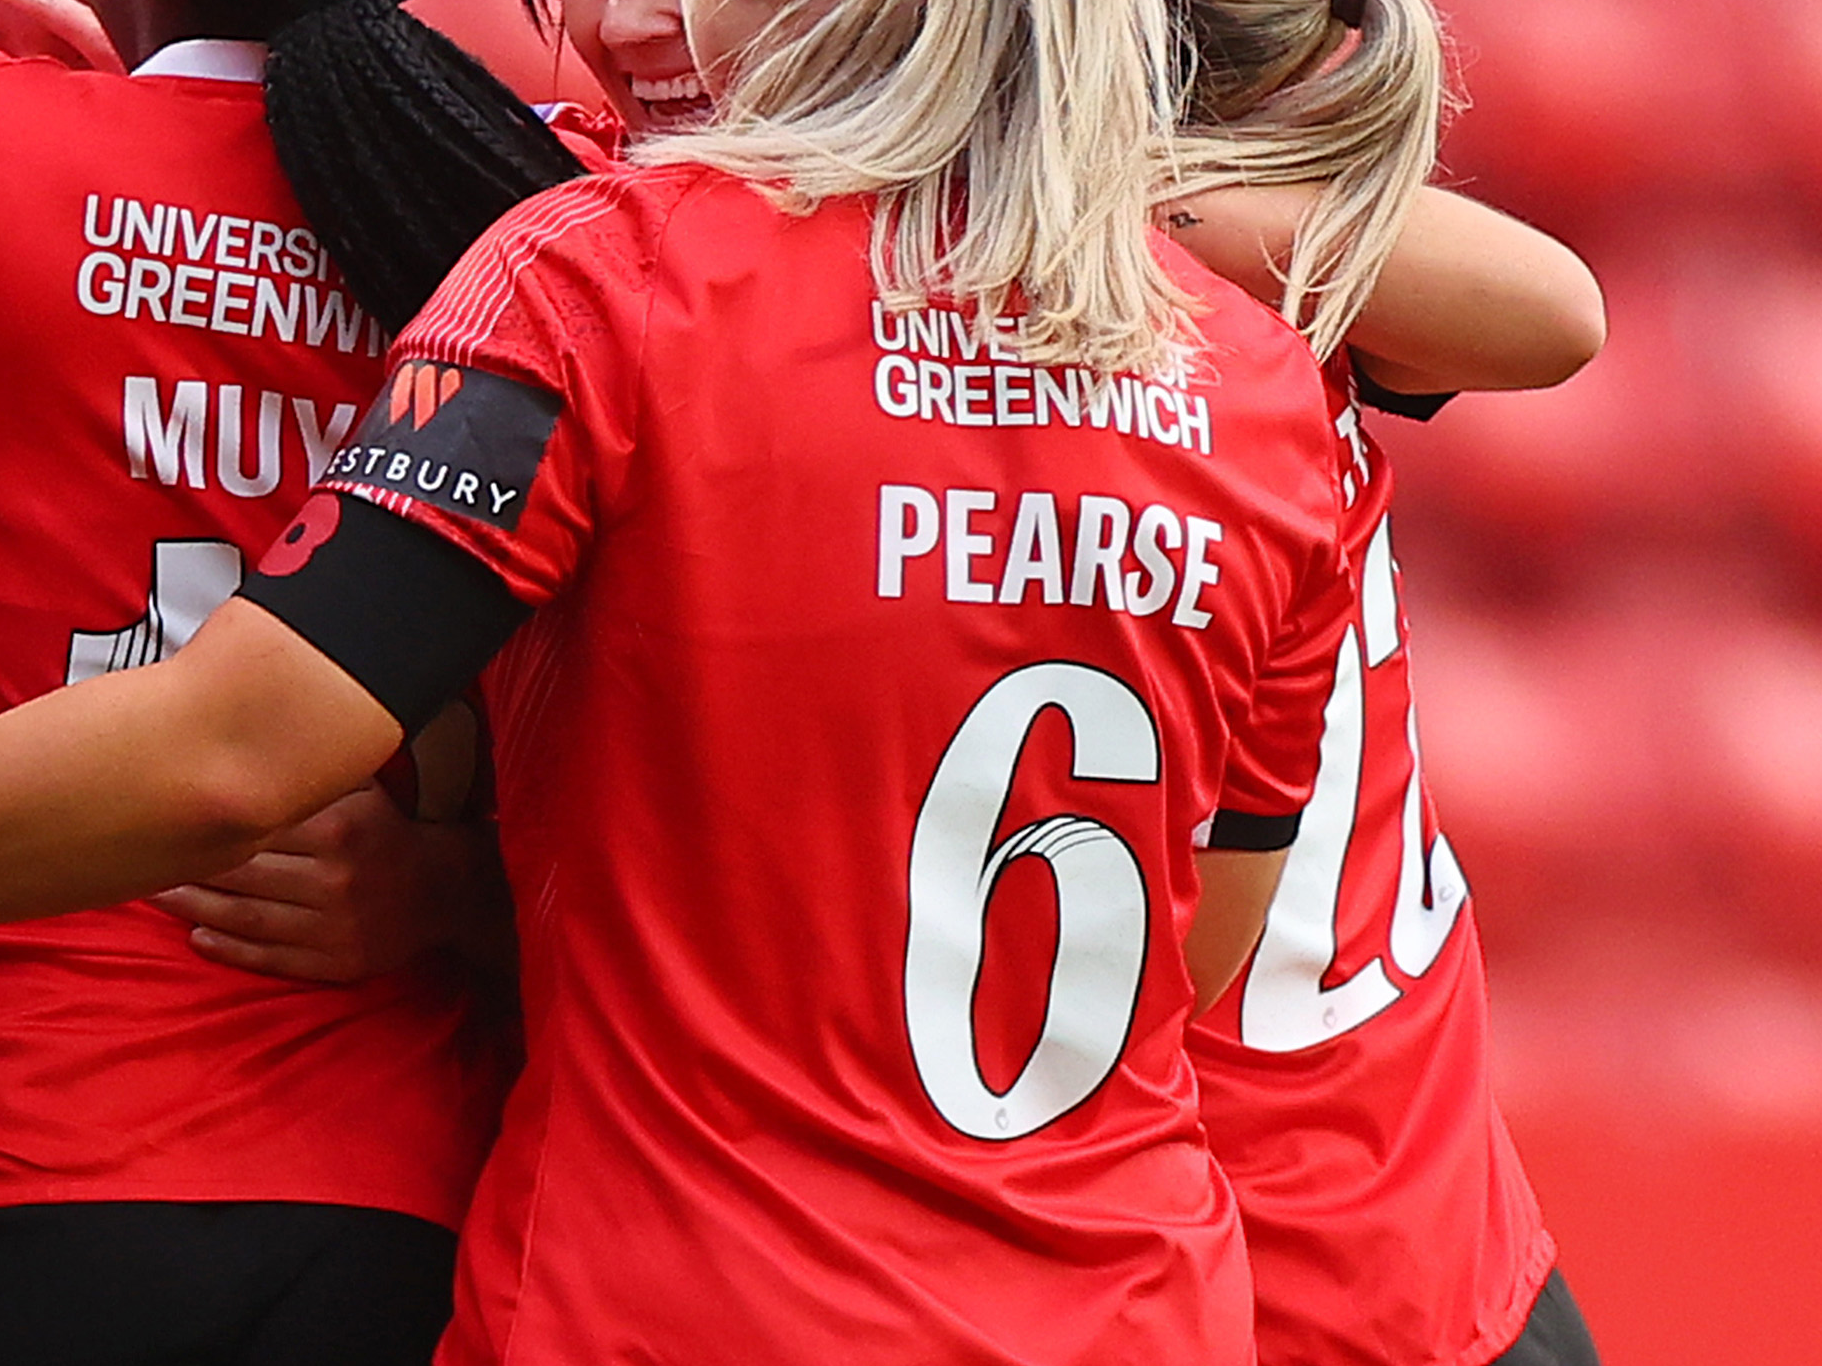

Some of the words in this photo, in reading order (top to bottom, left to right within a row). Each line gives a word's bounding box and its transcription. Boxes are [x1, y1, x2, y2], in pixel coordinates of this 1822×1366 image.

[83, 194, 331, 283] UNIVERSI
[77, 252, 391, 358] GREENWI
[871, 300, 1028, 363] UNIVE
[124, 376, 356, 498] MUY
[874, 353, 1212, 454] GREENWICH
[326, 446, 518, 514] ESTBURY
[877, 484, 1223, 629] PEARSE
[904, 658, 1159, 1141] 6
